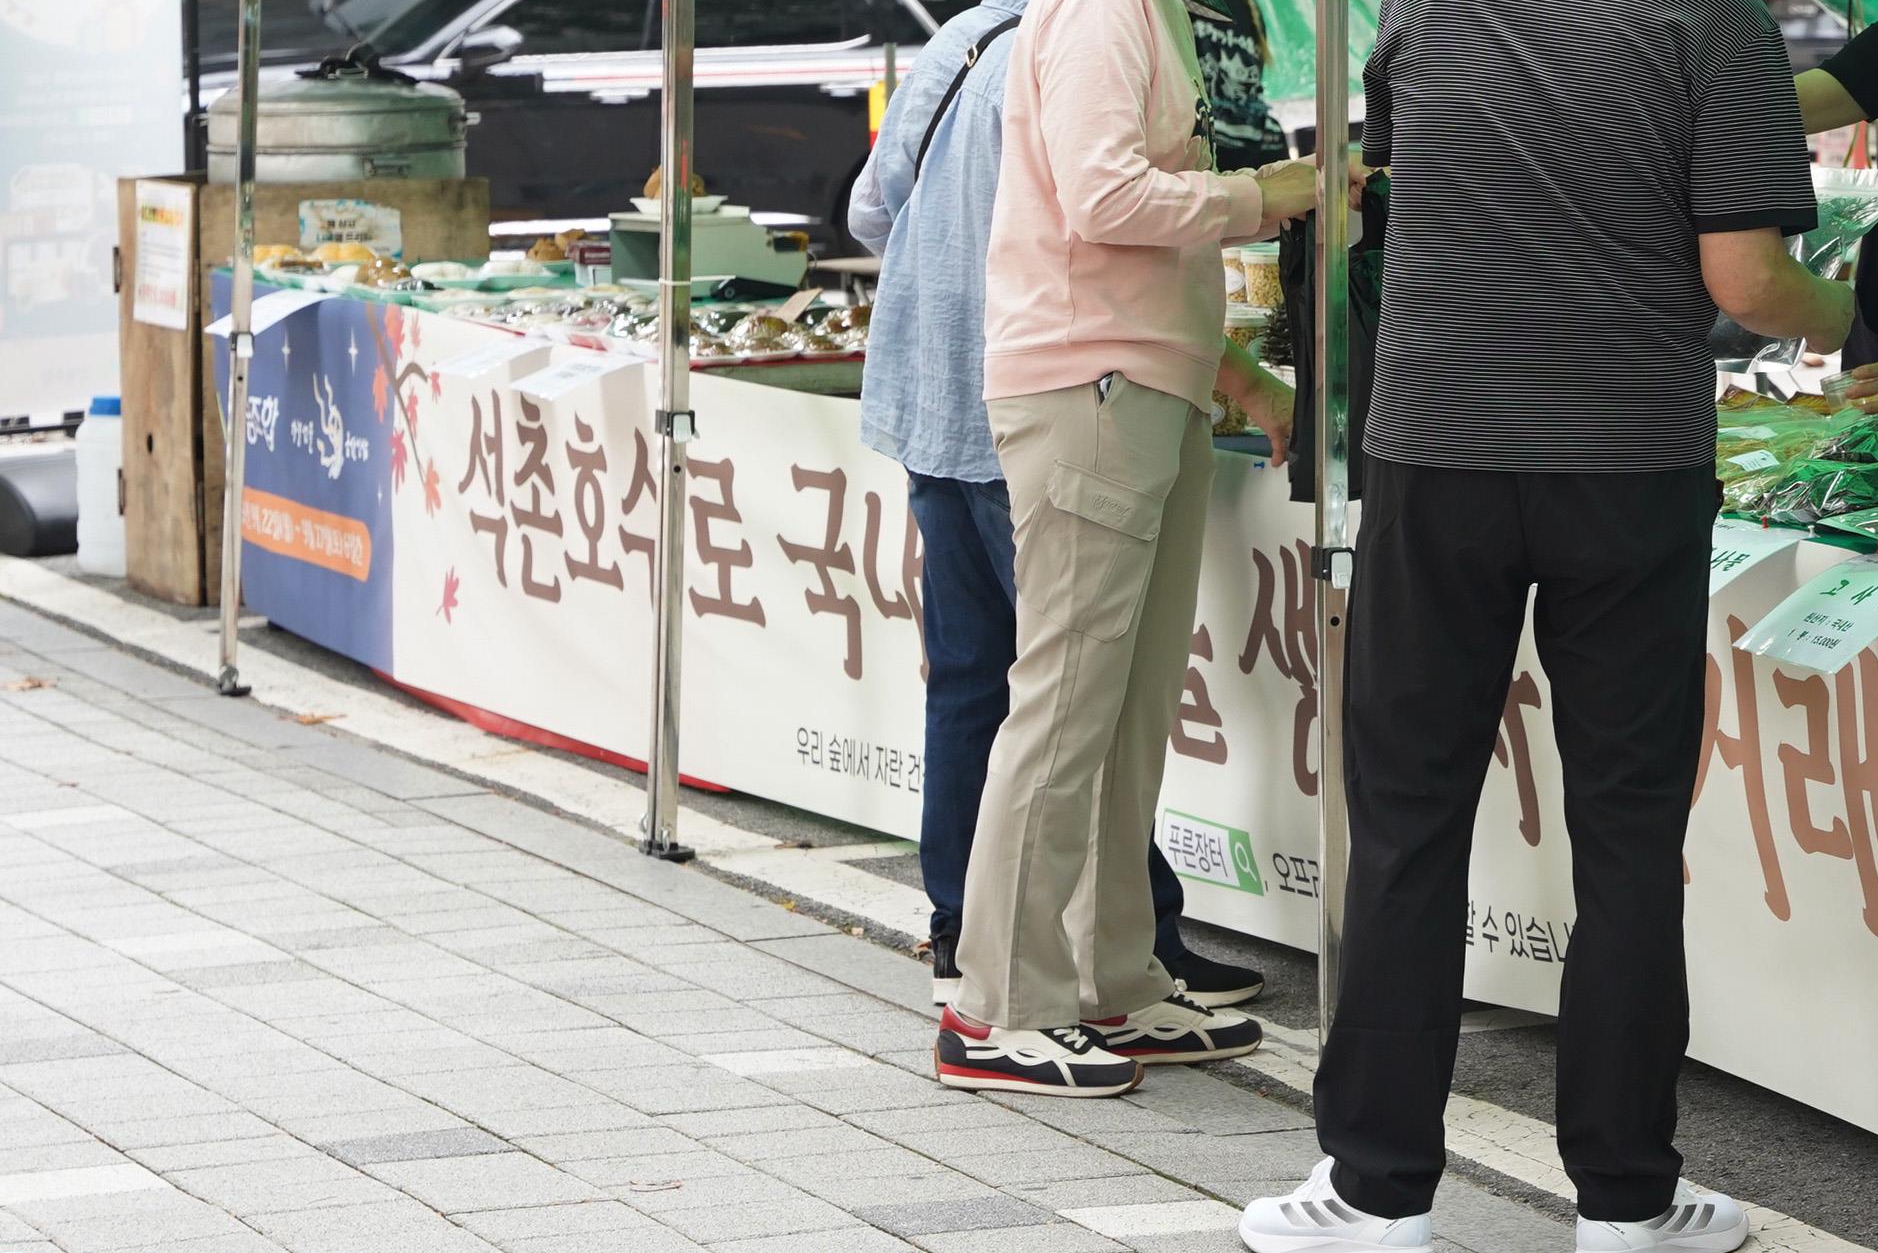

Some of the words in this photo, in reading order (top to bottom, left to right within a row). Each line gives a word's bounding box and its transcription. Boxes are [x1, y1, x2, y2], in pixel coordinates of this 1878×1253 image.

[1711, 547, 1751, 571] 나물
[795, 727, 822, 771] 우리
[827, 734, 870, 781] 숲에서
[874, 745, 902, 789] 자란
[1482, 906, 1499, 952] 수
[1504, 911, 1573, 964] 있습니
[1166, 823, 1227, 878] 푸른장터
